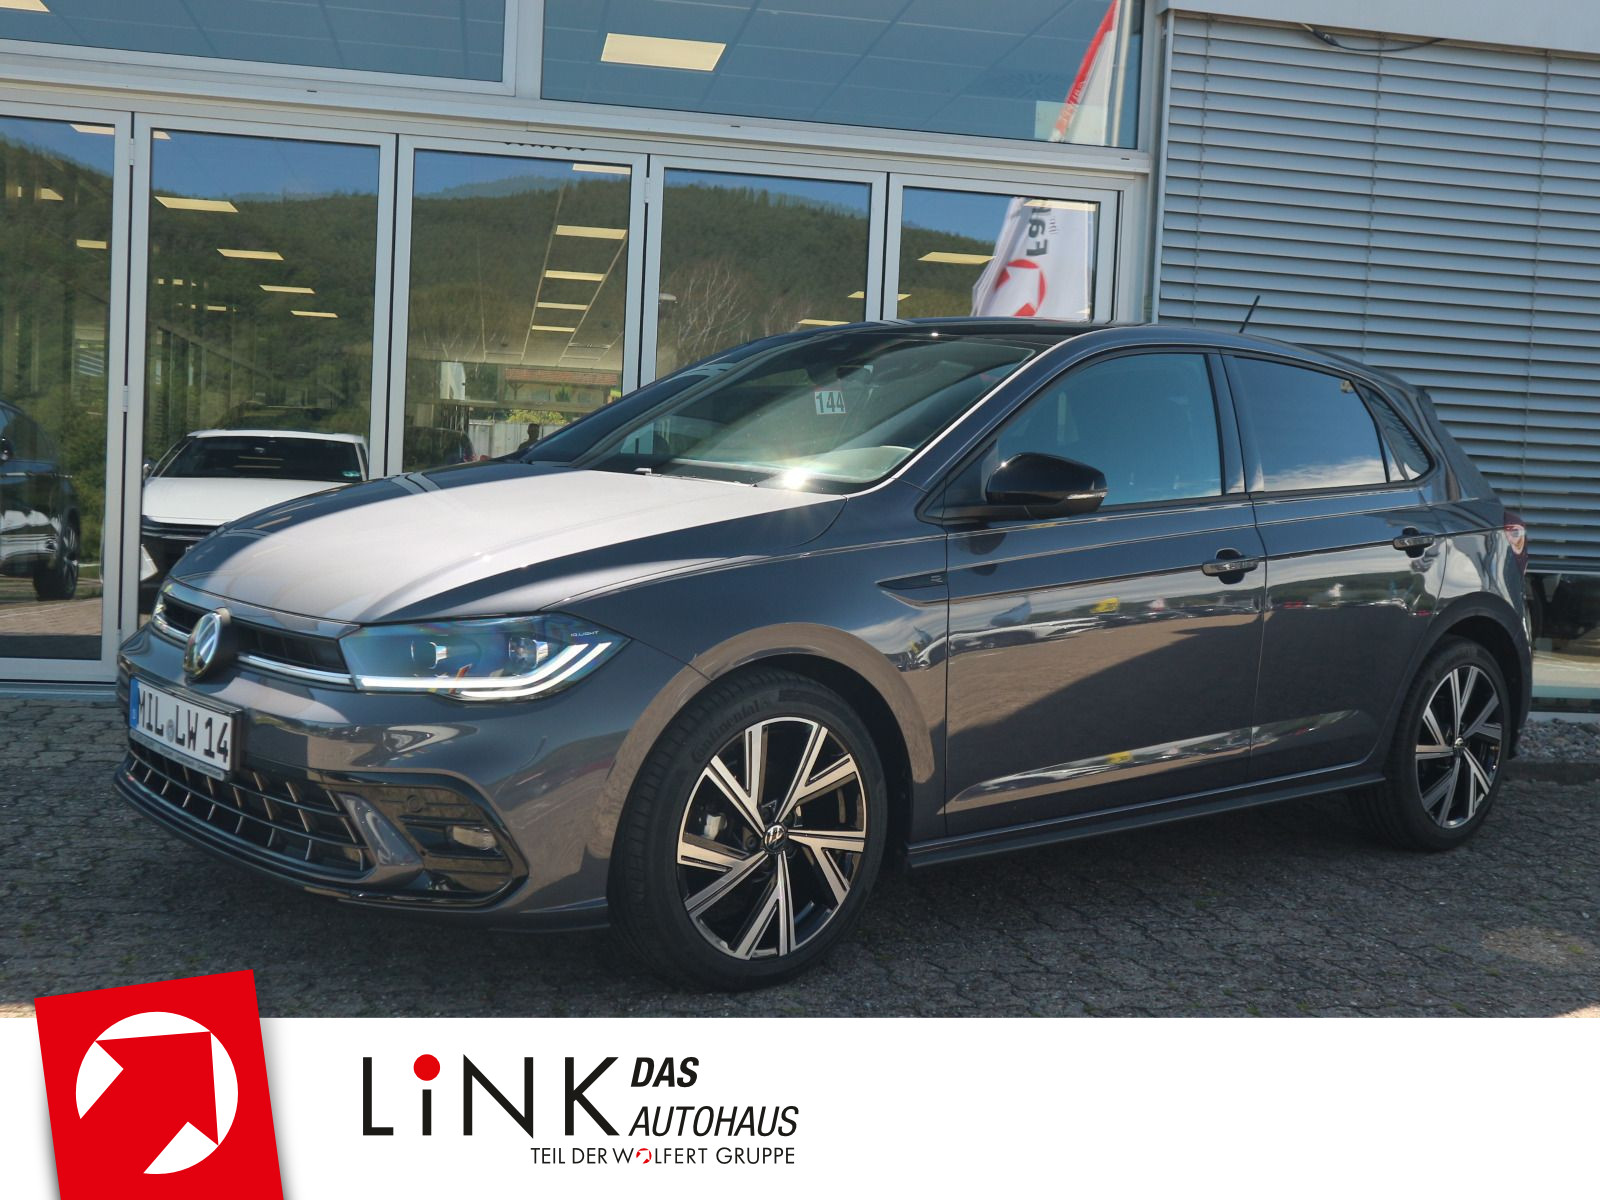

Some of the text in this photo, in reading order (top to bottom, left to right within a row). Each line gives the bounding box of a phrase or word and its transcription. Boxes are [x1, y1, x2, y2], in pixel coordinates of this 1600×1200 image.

[816, 391, 845, 413] 144
[139, 691, 164, 737] MIL
[175, 705, 199, 752] LW
[203, 717, 229, 763] 14
